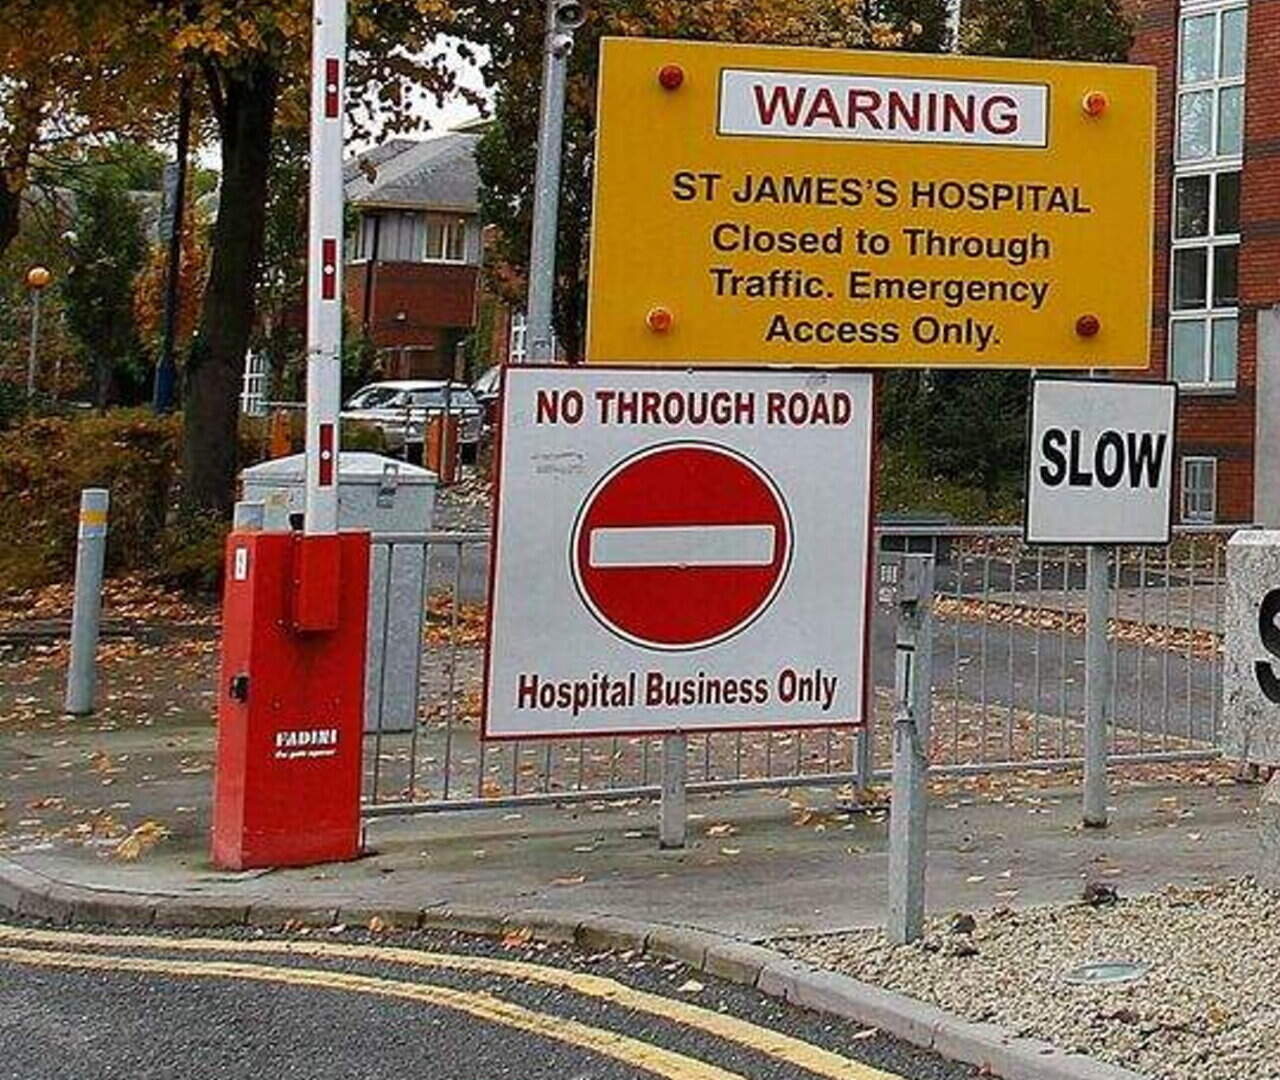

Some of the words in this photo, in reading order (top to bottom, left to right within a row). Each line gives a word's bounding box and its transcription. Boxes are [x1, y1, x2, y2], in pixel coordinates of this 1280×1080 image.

[753, 85, 1019, 135] WARNING
[673, 173, 720, 202] ST
[733, 175, 898, 209] JAMES'S
[911, 182, 1090, 214] HOSPITAL
[712, 223, 842, 255] Closed
[856, 229, 890, 256] to
[904, 229, 1050, 265] Through
[710, 269, 834, 299] Traffic.
[849, 272, 1048, 308] Emergency
[766, 315, 899, 343] Access
[913, 316, 1001, 351] Only.
[536, 390, 583, 425] NO
[597, 390, 754, 427] THROUGH
[767, 390, 851, 425] ROAD
[1040, 429, 1166, 488] SLOW
[517, 673, 636, 717] Hospital
[646, 671, 768, 706] Business
[778, 668, 838, 712] Only
